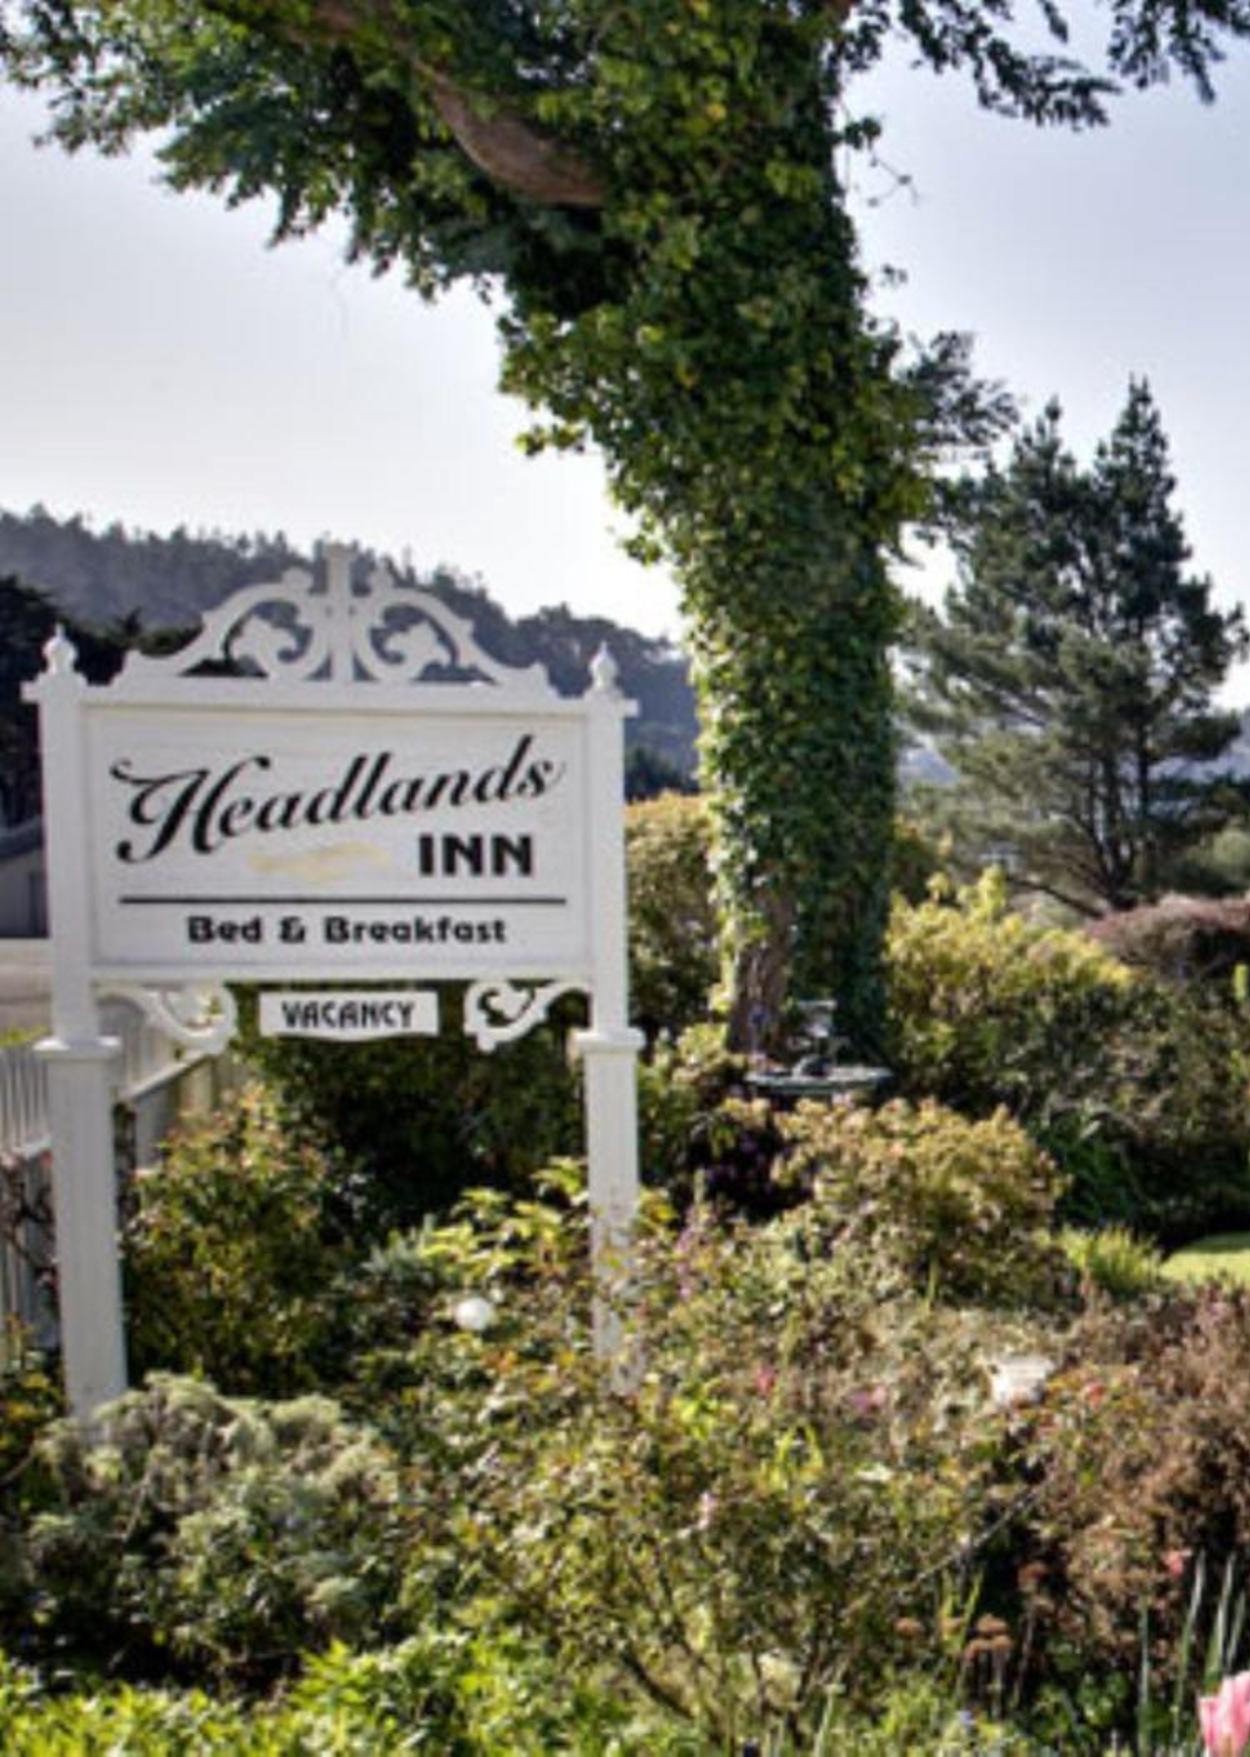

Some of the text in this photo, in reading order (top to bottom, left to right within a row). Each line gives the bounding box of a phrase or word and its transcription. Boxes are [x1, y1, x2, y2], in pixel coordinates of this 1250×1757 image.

[109, 733, 565, 865] Headlands
[418, 833, 534, 877] INN
[187, 914, 508, 945] Bed & Breakfast
[281, 1000, 416, 1028] VACANCY
